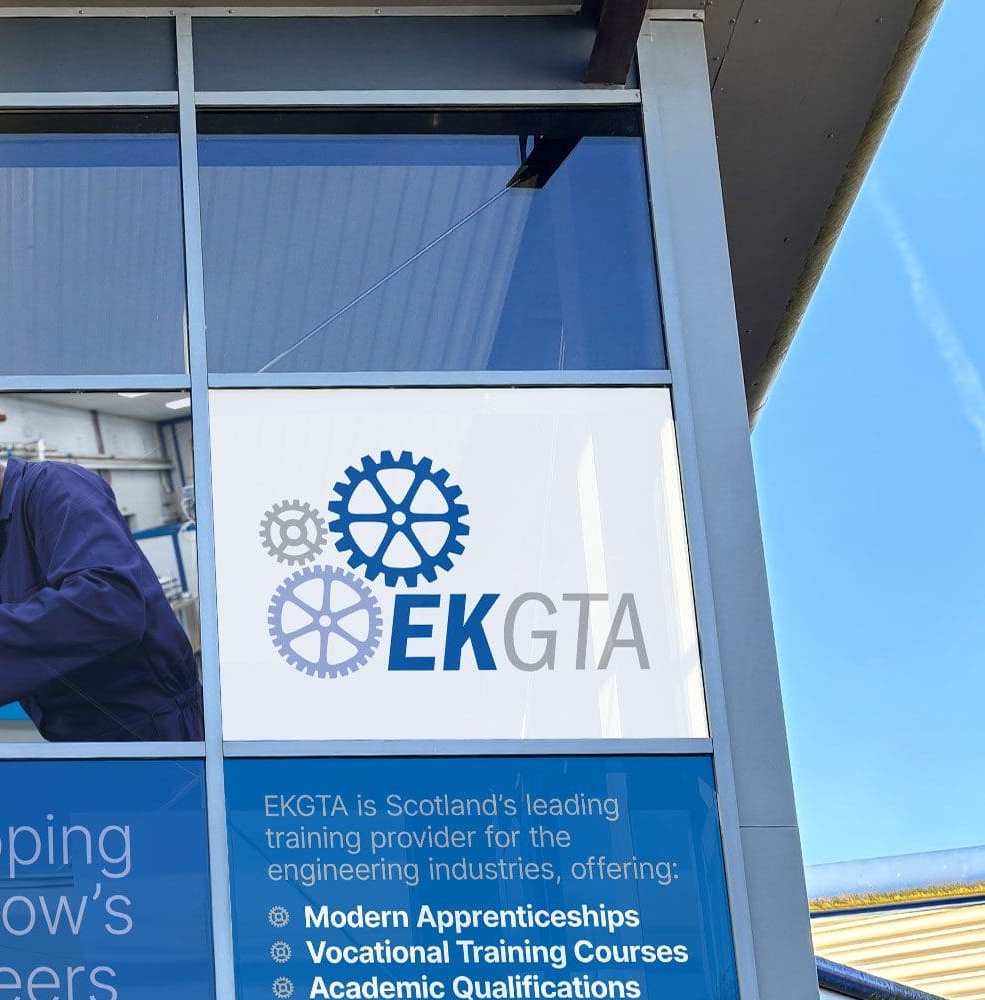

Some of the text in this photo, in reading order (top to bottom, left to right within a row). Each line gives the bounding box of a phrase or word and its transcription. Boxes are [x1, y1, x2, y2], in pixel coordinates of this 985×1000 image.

[387, 591, 651, 671] EKGTA
[264, 792, 620, 822] EKGTA is Scotland’s leading
[265, 825, 571, 855] training provider for the
[267, 856, 680, 887] engineering industries, offering:
[304, 903, 640, 934] Modern Apprenticeships
[306, 938, 689, 969] Vocational Training Courses
[309, 974, 641, 1000] Academic Qualifications
